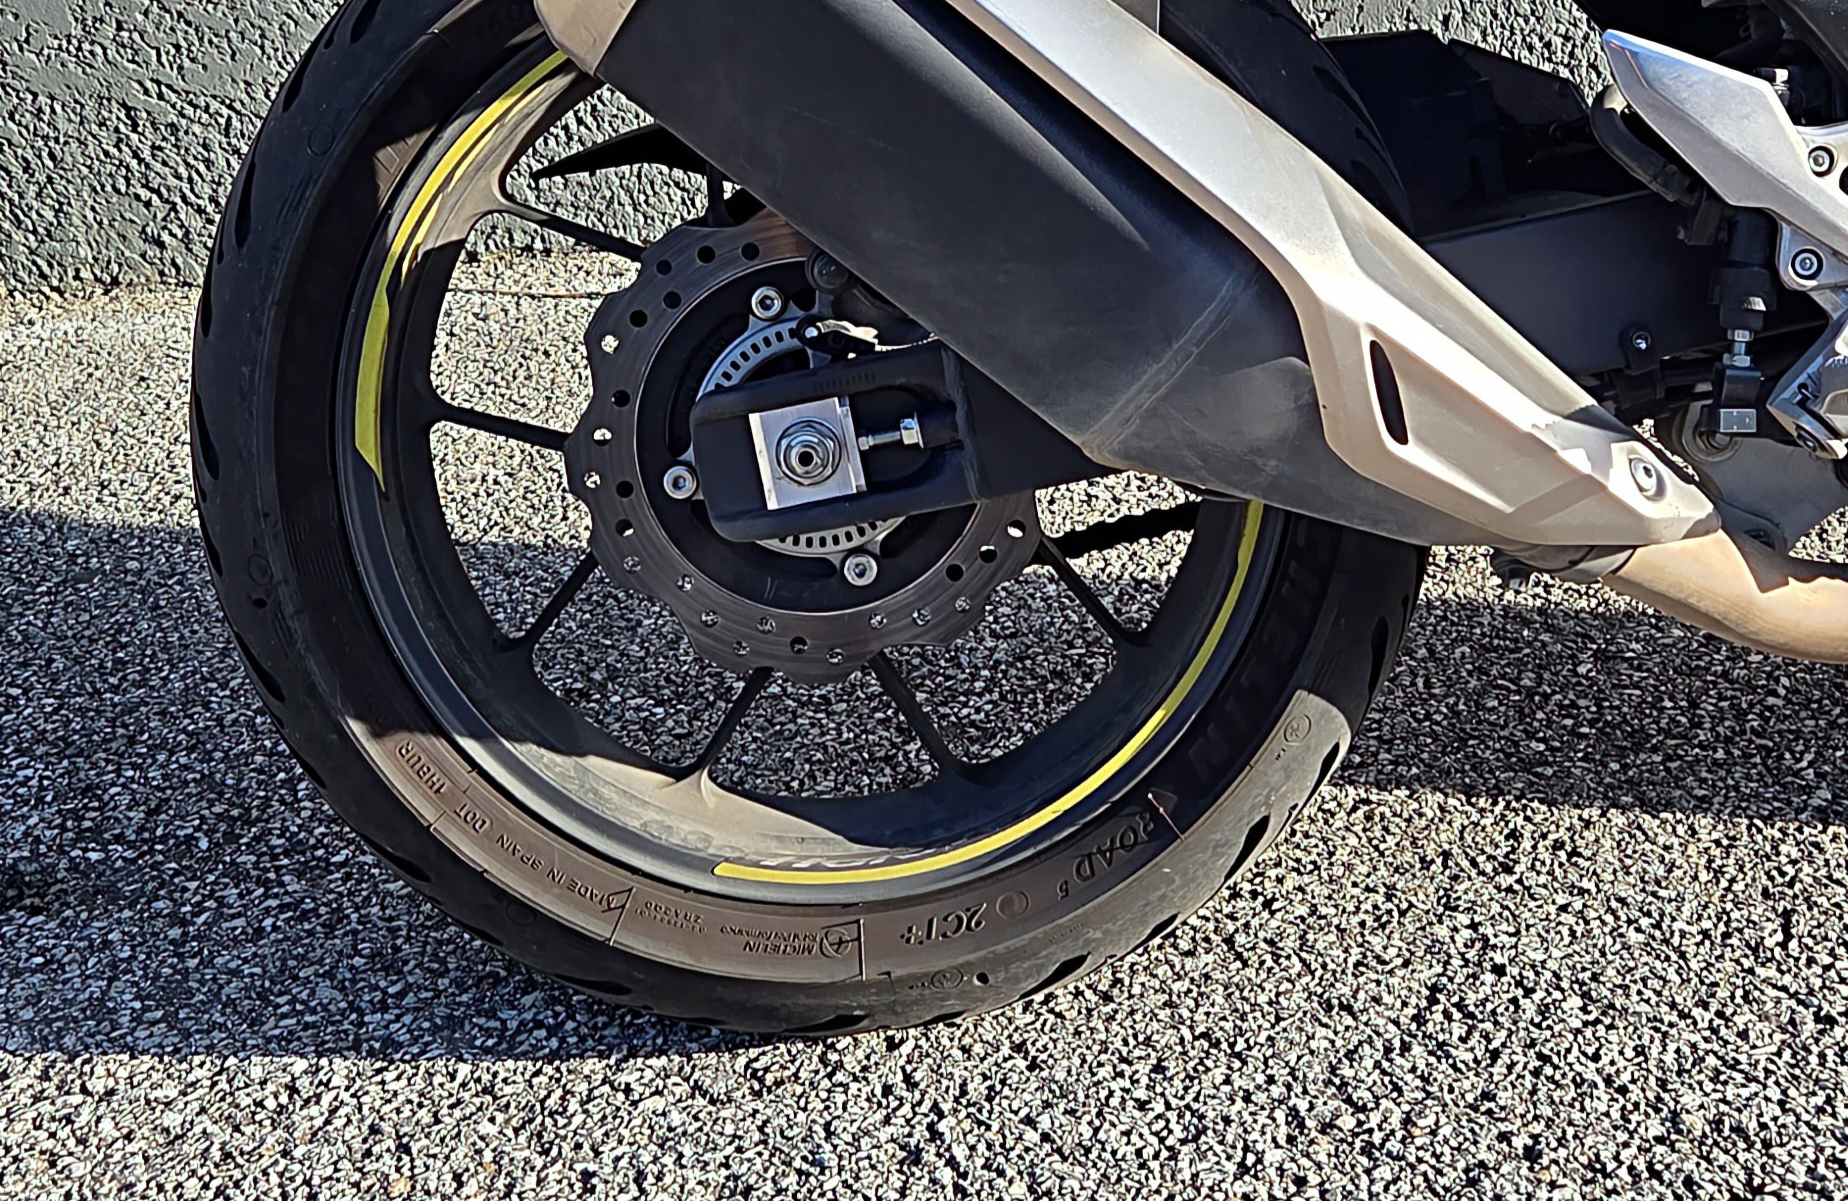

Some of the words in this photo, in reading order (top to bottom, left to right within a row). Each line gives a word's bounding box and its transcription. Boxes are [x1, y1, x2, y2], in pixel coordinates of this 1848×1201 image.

[454, 803, 487, 832] DOT
[496, 834, 544, 872] SPAIN
[1072, 812, 1154, 884] ROAD
[546, 866, 567, 884] IN
[569, 877, 615, 909] MADE
[742, 940, 815, 955] MICHELIN
